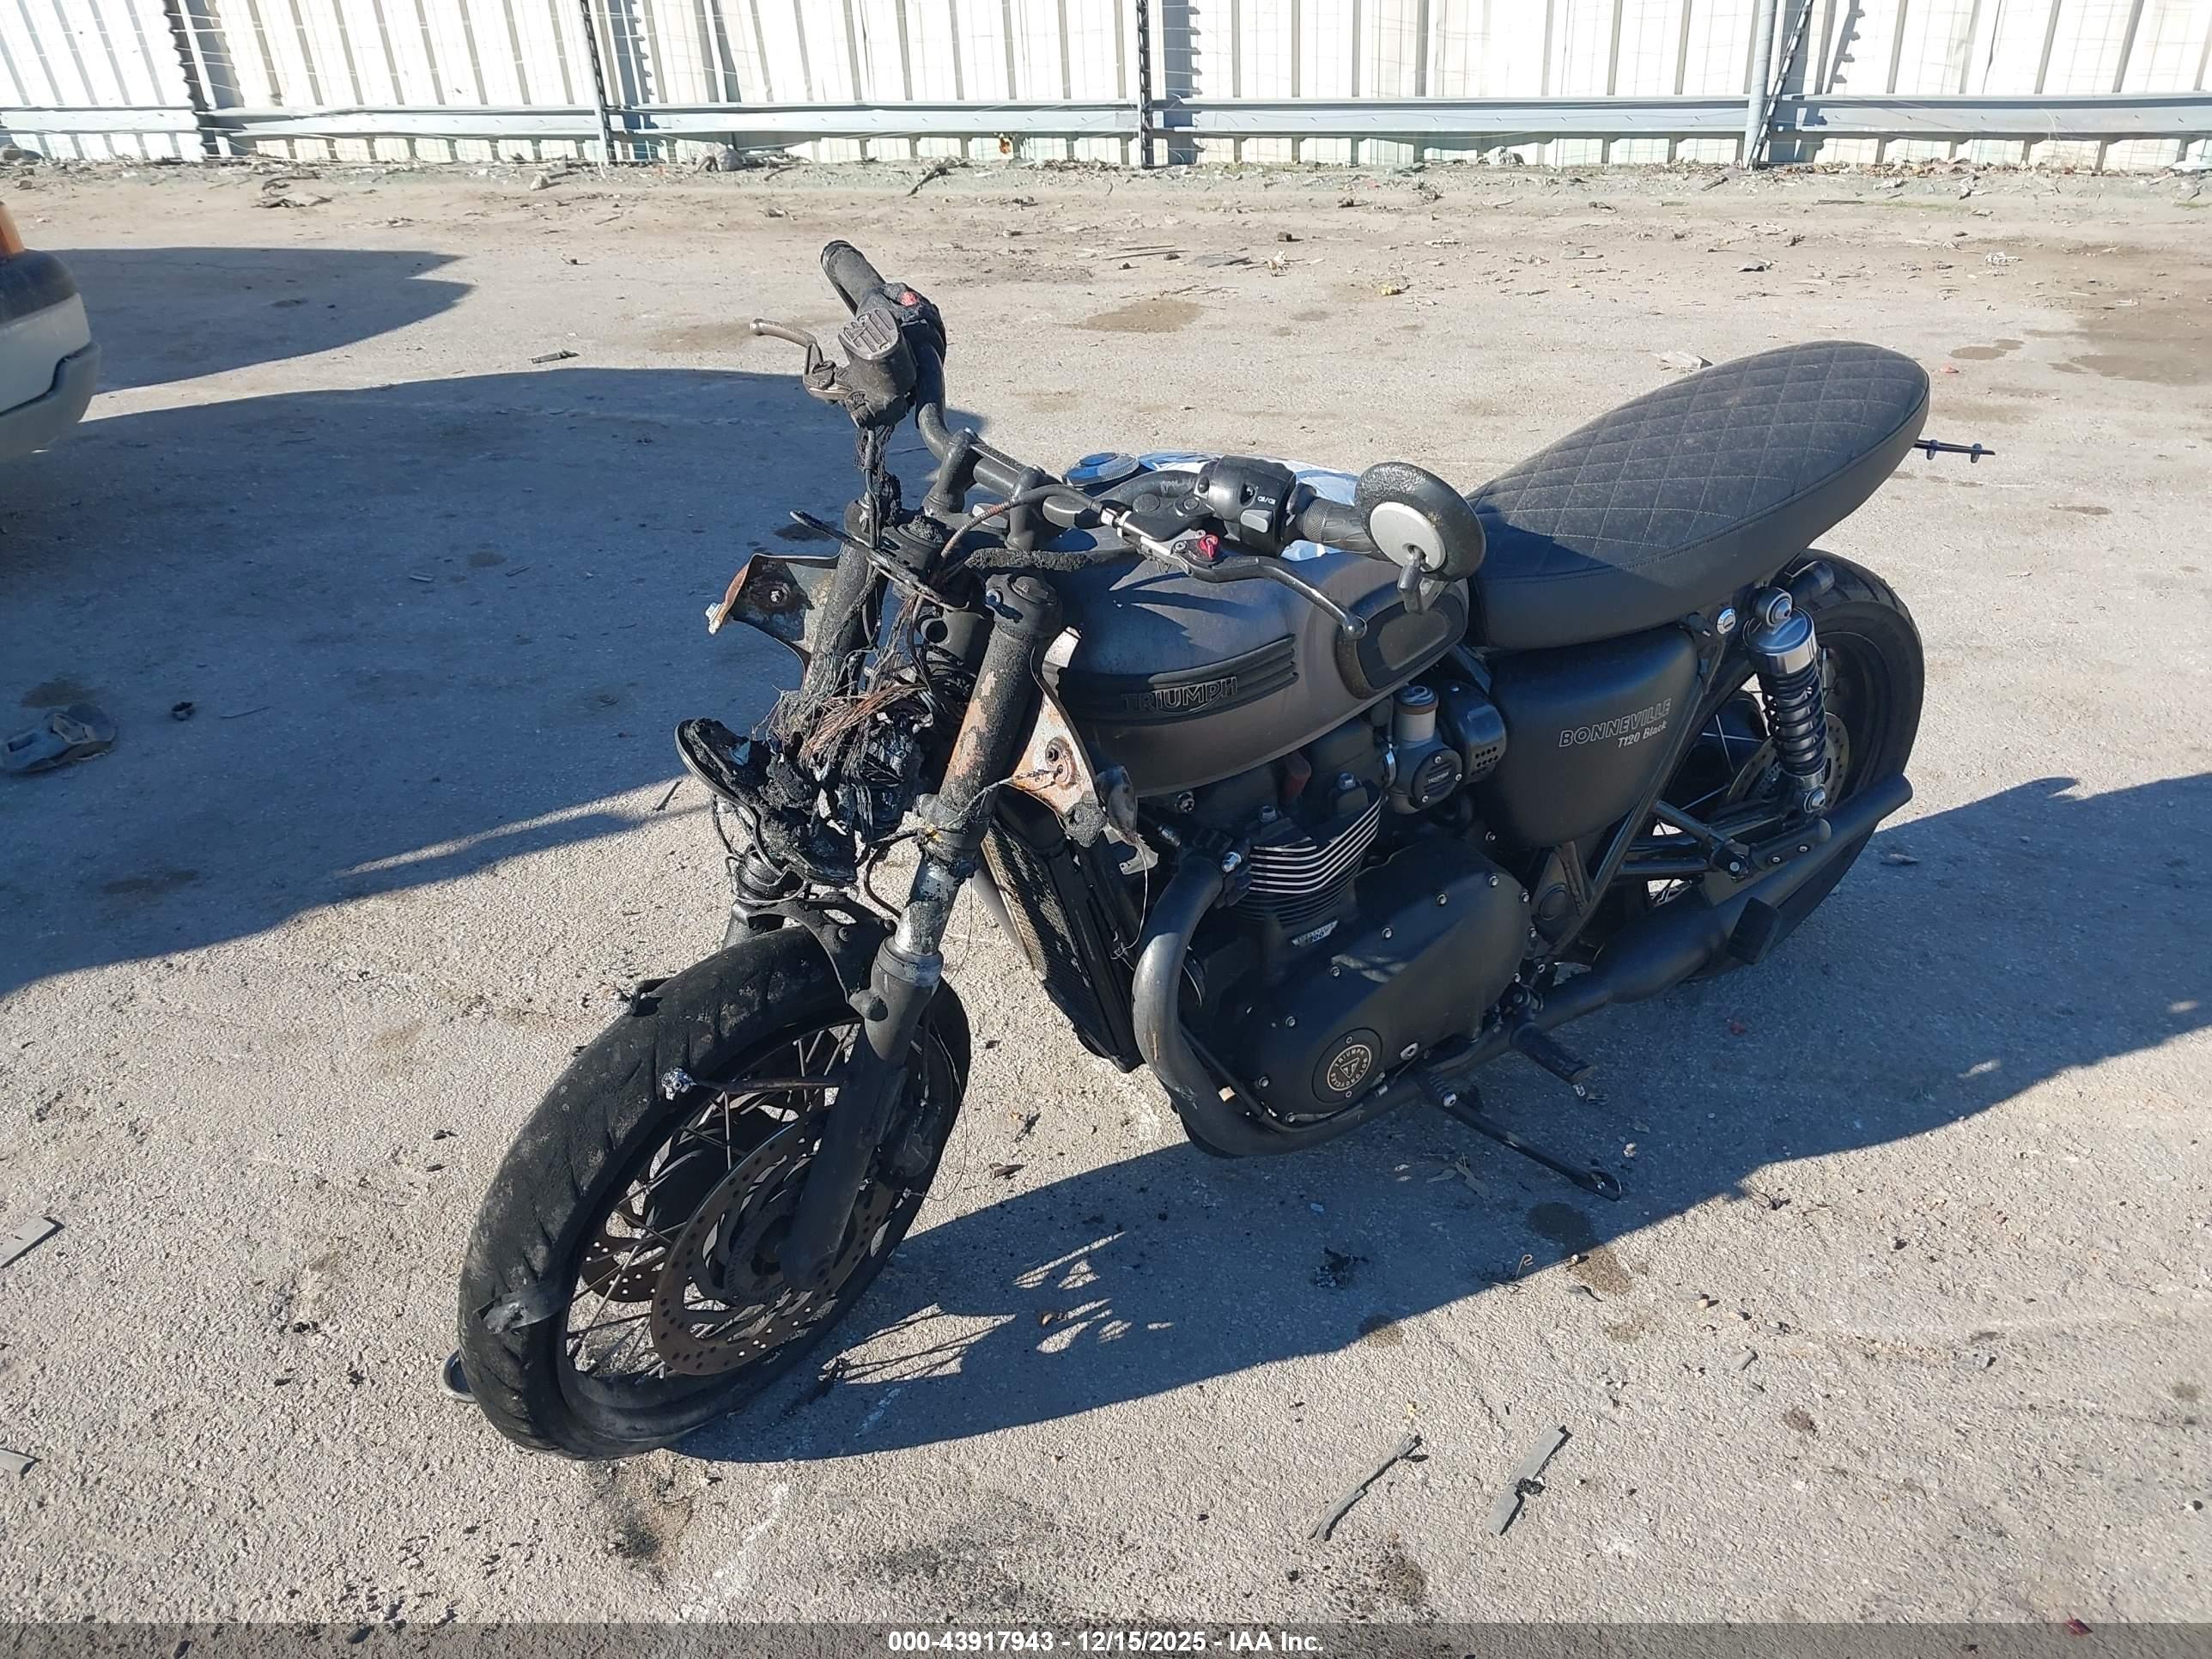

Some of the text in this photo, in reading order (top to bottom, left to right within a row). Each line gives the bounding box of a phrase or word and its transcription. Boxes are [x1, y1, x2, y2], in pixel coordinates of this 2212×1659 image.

[1121, 676, 1238, 713] TRIUMPH
[1559, 698, 1671, 747] BONNEVILLE
[1618, 720, 1668, 749] T120 Black
[1334, 1048, 1364, 1067] TRIUMPH
